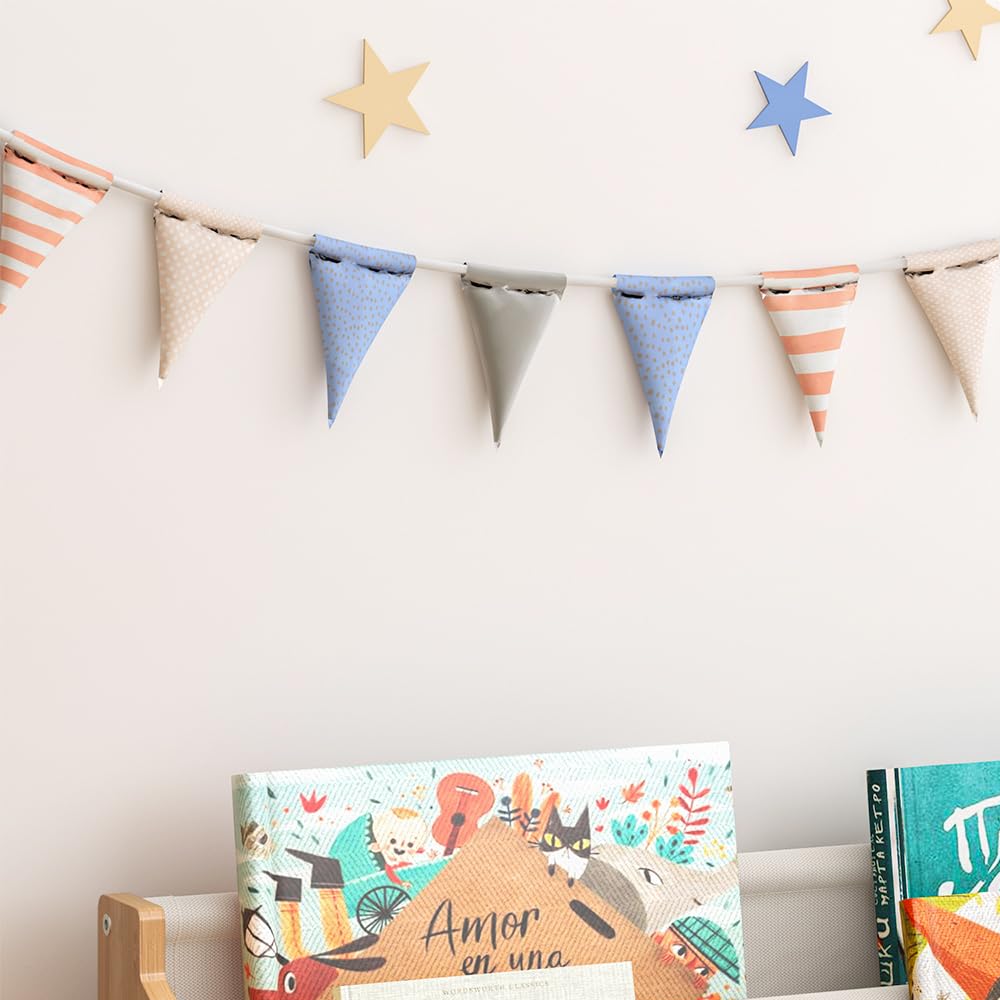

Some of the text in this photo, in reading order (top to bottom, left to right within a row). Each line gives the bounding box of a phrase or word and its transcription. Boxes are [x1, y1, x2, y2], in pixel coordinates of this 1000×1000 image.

[871, 782, 884, 845] КЕТРО
[421, 900, 543, 955] Amor
[460, 947, 572, 976] en una
